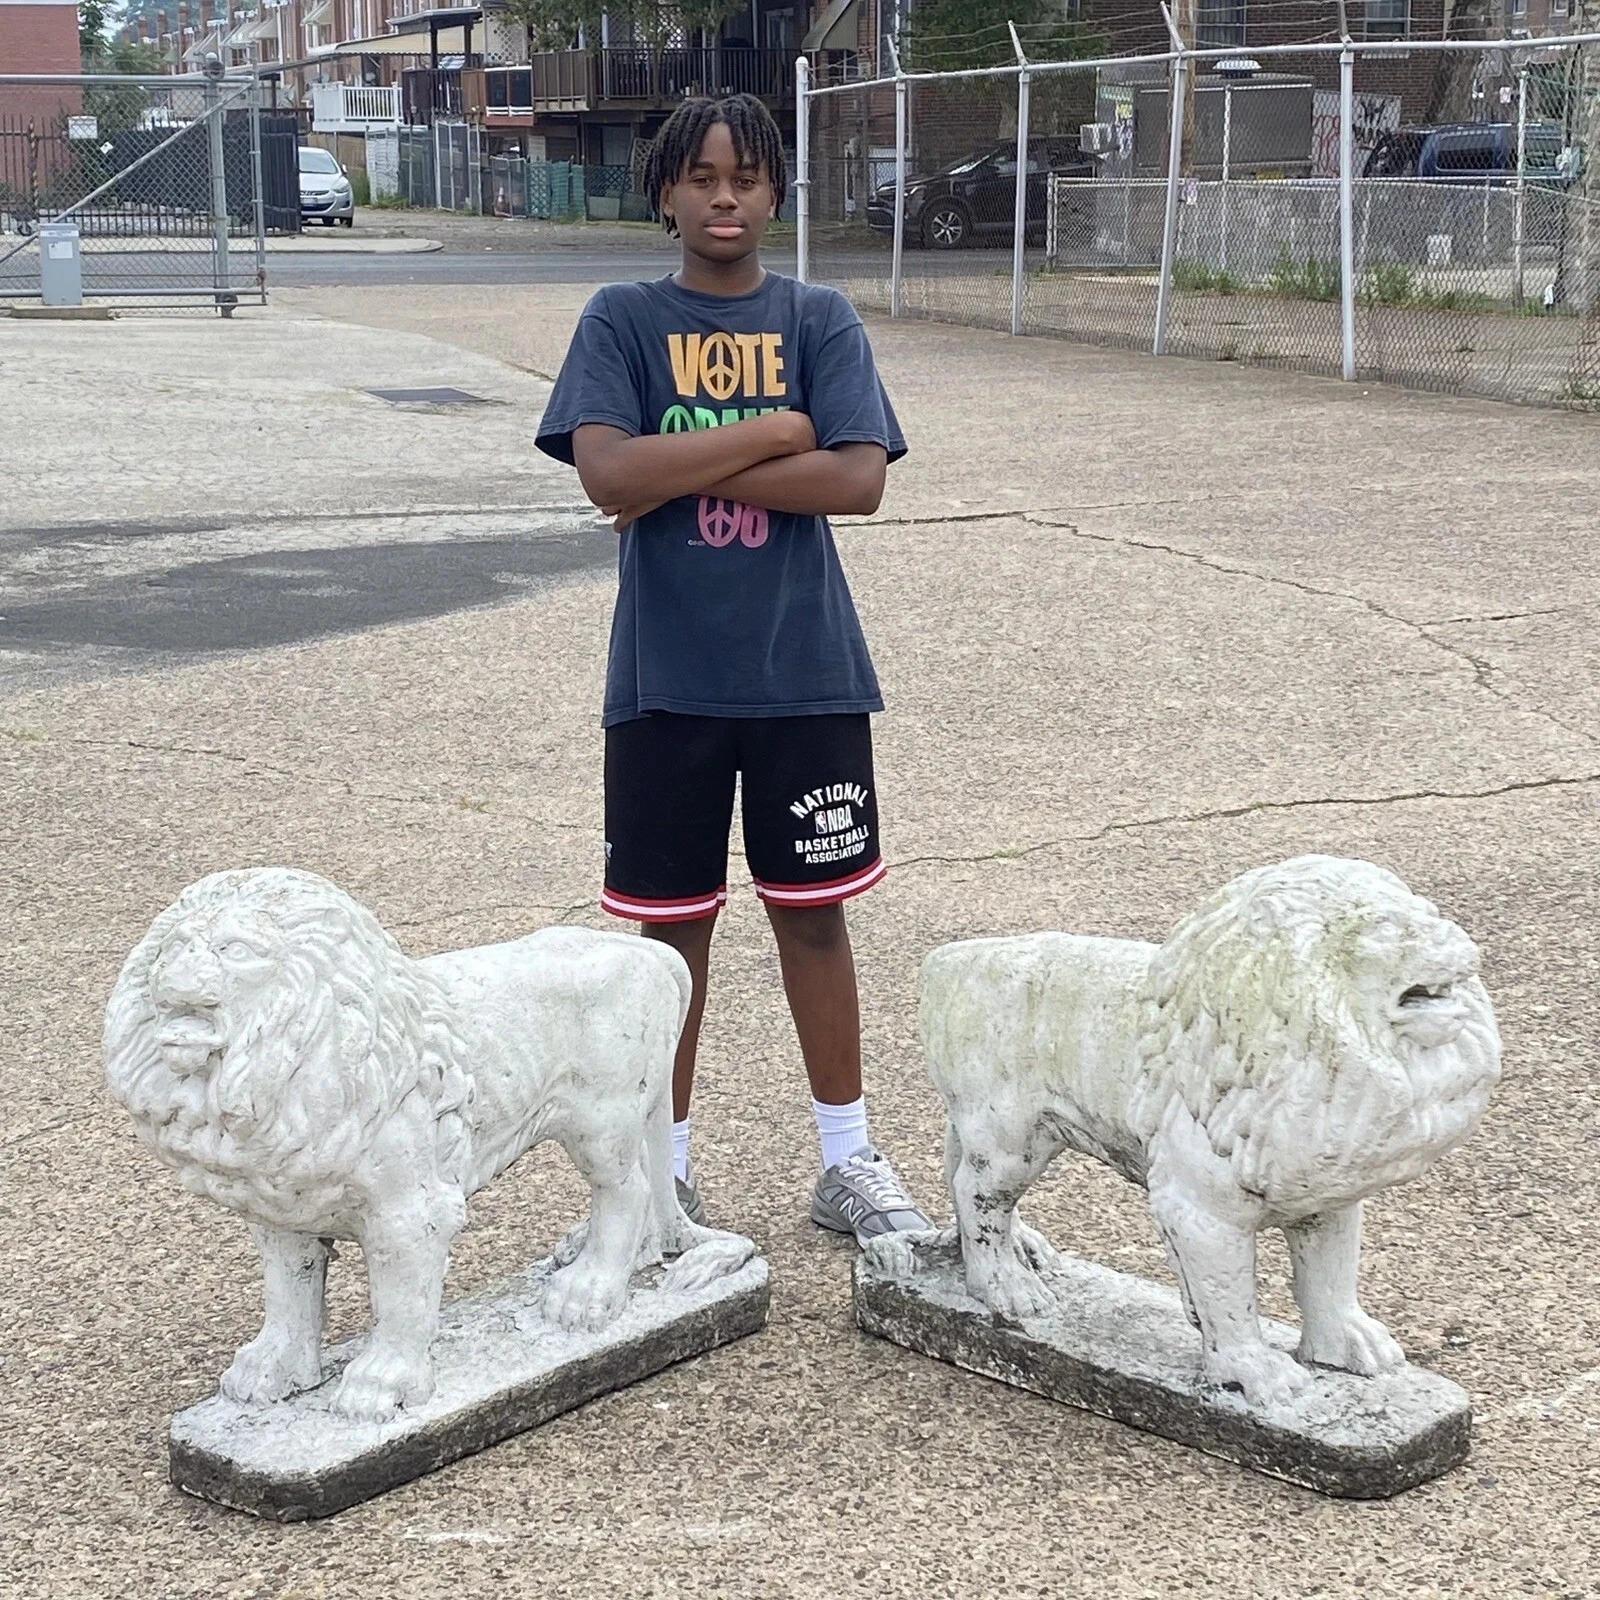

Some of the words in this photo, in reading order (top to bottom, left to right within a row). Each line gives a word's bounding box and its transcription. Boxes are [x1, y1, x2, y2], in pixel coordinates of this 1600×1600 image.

[667, 332, 786, 400] VOTE
[789, 782, 868, 819] NATIONAL
[827, 804, 854, 833] NBA
[795, 824, 869, 853] BASKETBALL
[805, 841, 866, 864] ASSOCIATION
